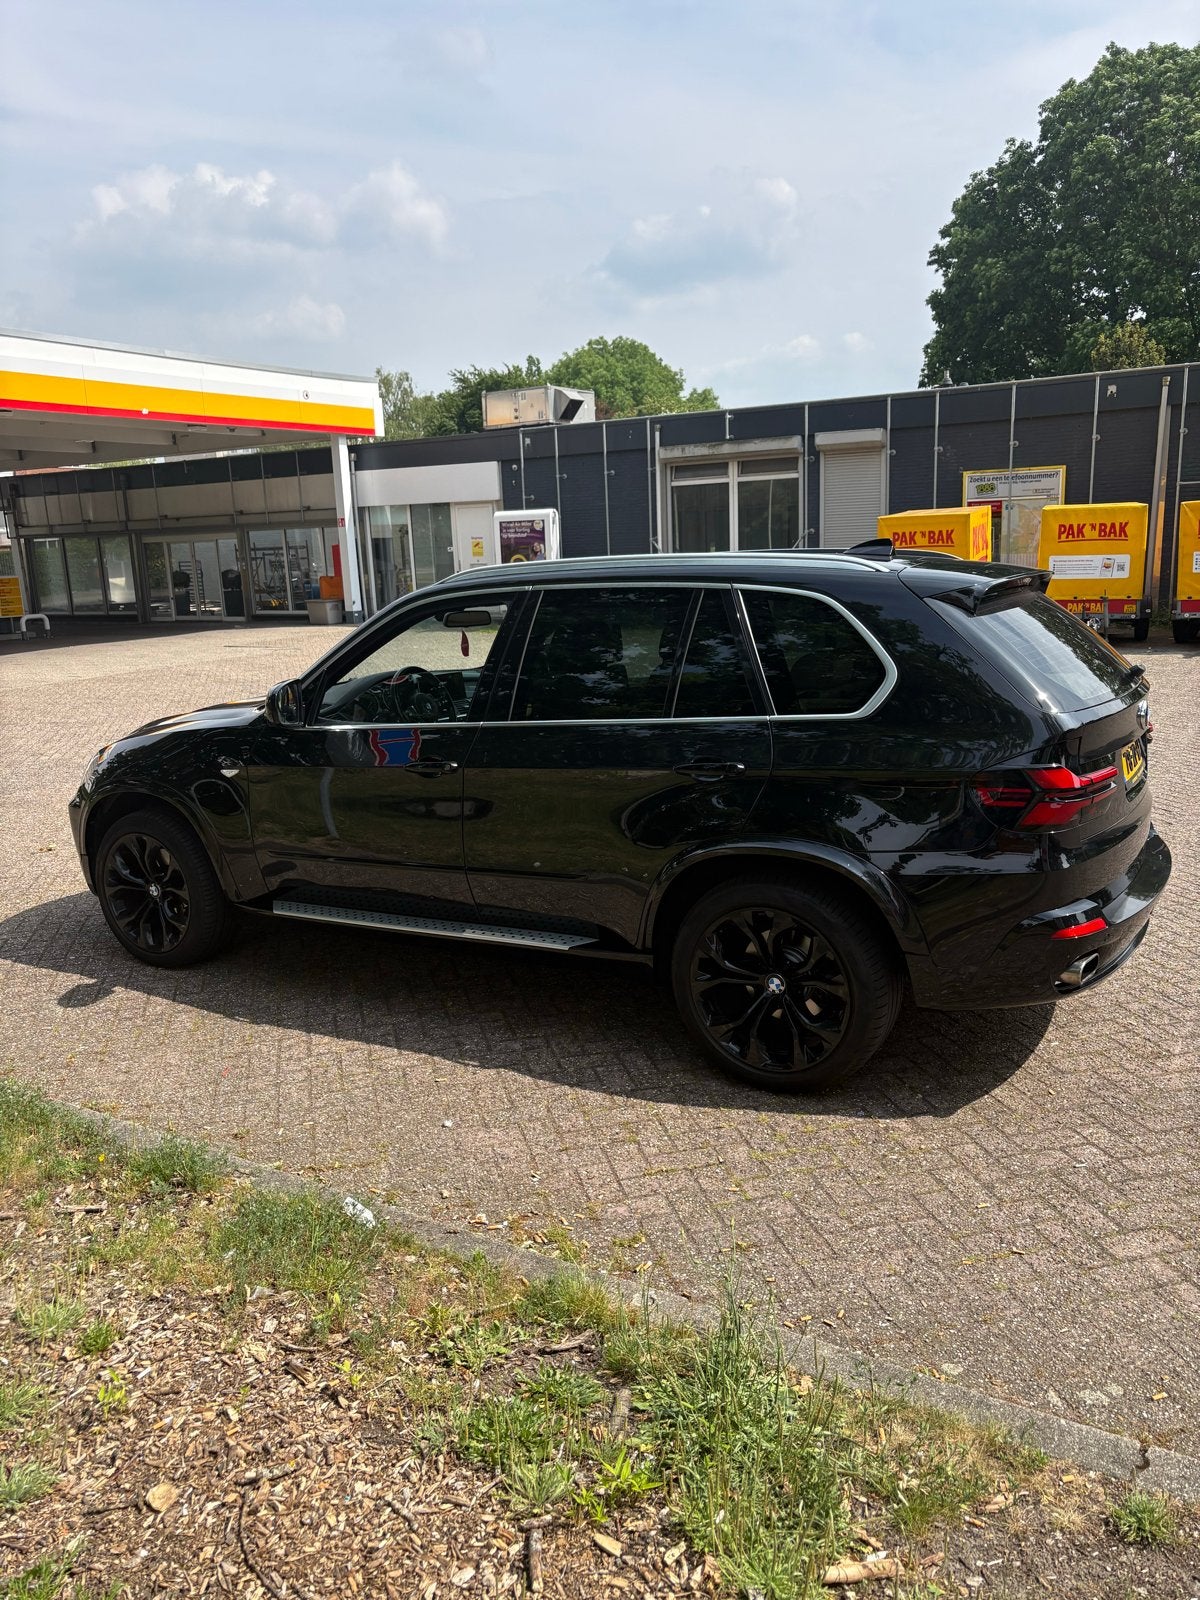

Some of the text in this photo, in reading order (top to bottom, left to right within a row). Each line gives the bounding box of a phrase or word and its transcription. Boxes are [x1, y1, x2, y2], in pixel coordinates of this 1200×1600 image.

[1004, 471, 1059, 481] teefoonnummer?
[892, 531, 917, 545] PAK
[928, 528, 955, 544] BAK
[1058, 523, 1087, 540] PAK
[1098, 520, 1129, 538] BAK
